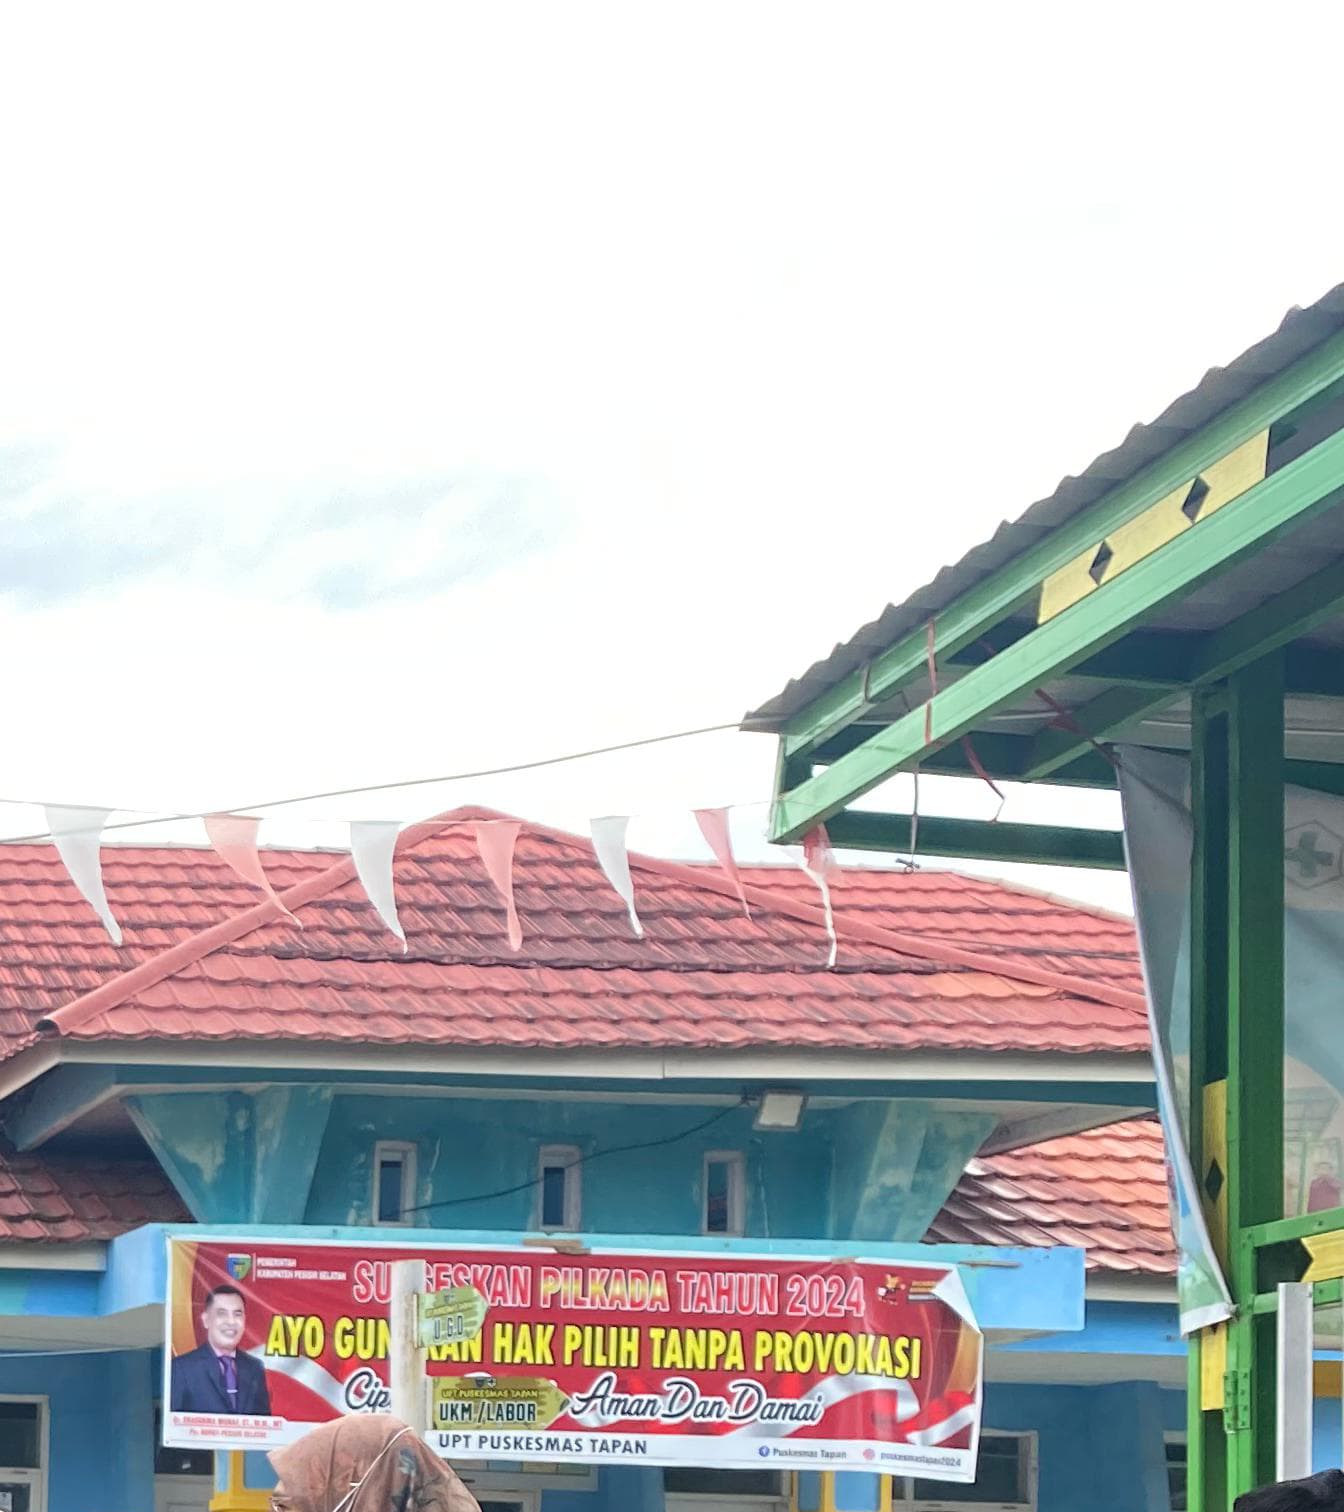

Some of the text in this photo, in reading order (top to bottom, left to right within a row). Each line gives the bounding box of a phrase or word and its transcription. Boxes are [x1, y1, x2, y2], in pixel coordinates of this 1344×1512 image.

[540, 1266, 670, 1313] PILKADA
[676, 1270, 780, 1316] TAHUN
[786, 1274, 866, 1318] 2024
[265, 1314, 325, 1359] AYO
[493, 1321, 555, 1366] HAK
[563, 1323, 640, 1369] PILIH
[650, 1327, 746, 1371] TANPA
[755, 1330, 922, 1380] PROVOKASI
[459, 1388, 509, 1400] PUSKESMAS
[570, 1374, 661, 1417] Aman
[661, 1380, 727, 1420] Dan
[728, 1382, 823, 1422] Damai
[439, 1402, 472, 1422] UKM
[439, 1433, 648, 1455] UPT PUSKESMAS TAPAN
